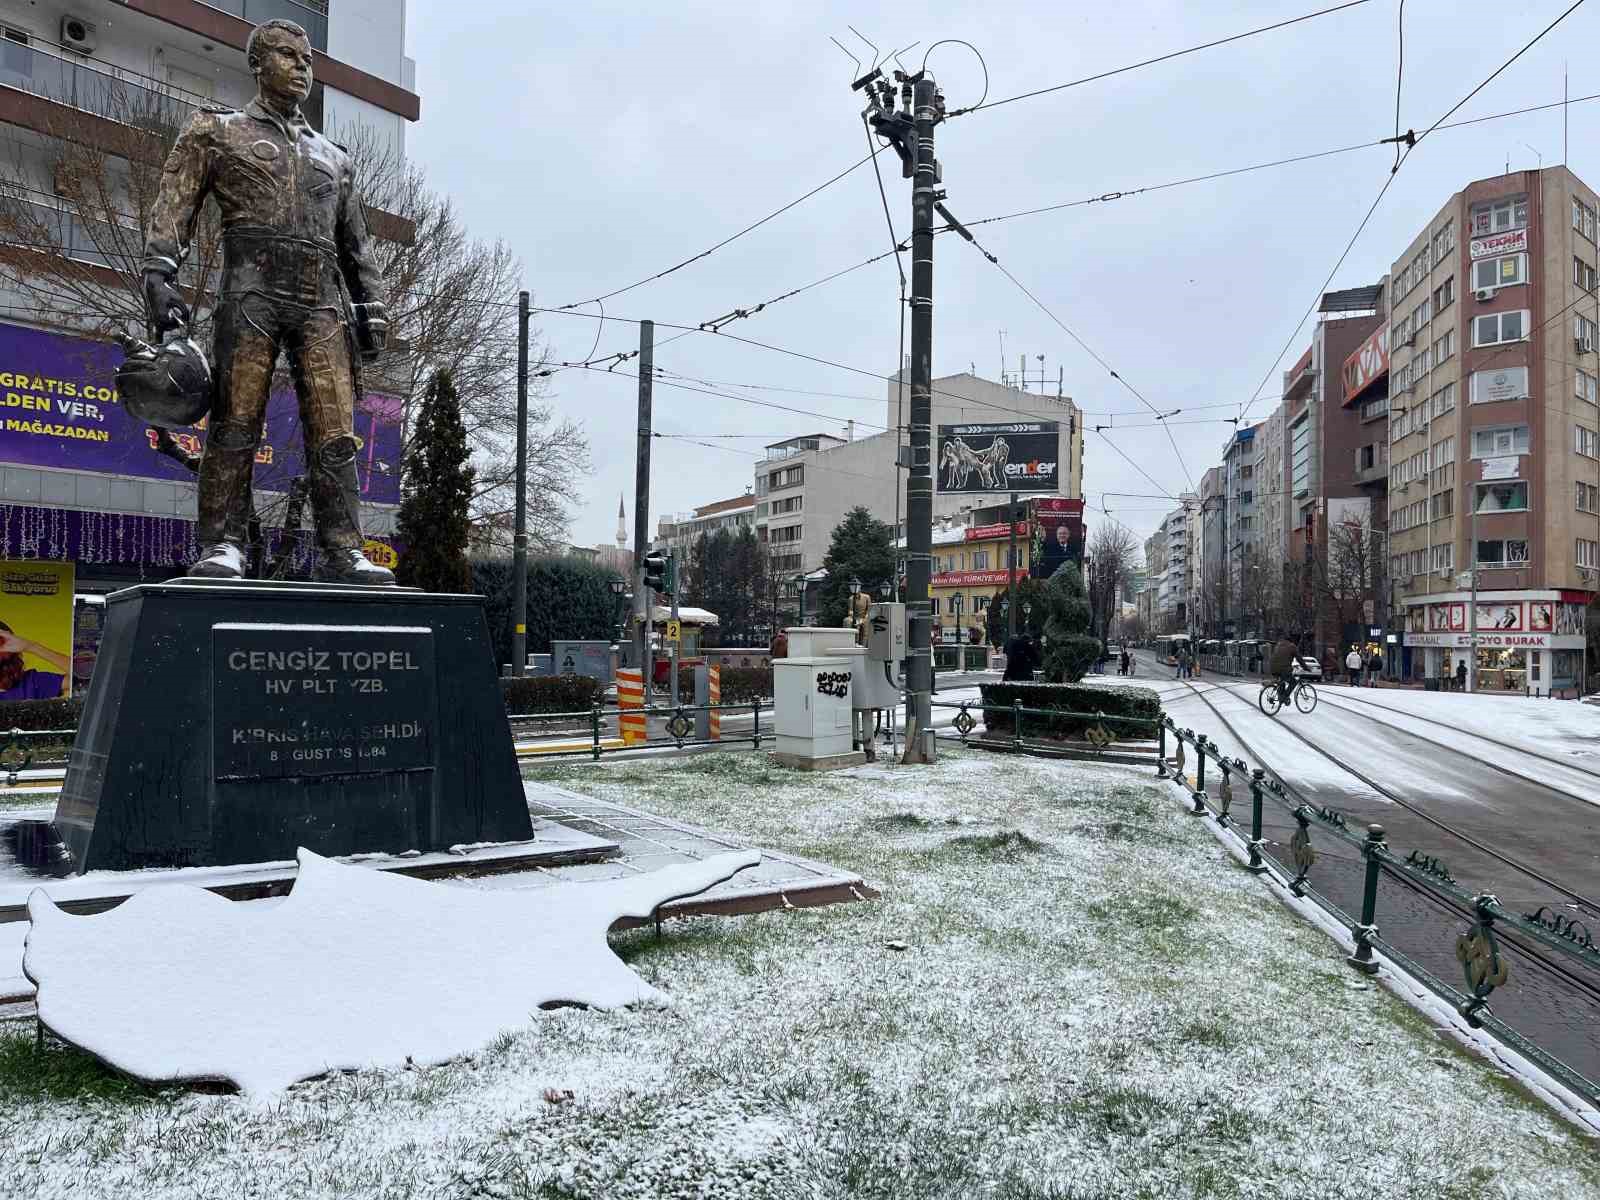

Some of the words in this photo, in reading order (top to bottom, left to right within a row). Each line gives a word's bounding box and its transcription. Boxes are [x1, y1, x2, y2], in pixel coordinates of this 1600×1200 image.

[0, 372, 118, 404] GRATIS.CO
[57, 399, 105, 422] VER,
[6, 416, 109, 441] MAĞAZADAN
[1005, 457, 1056, 475] ender
[670, 625, 677, 637] 2
[1505, 636, 1545, 646] BURAK
[228, 648, 331, 671] CENGİZ
[338, 650, 419, 671] TOPEL
